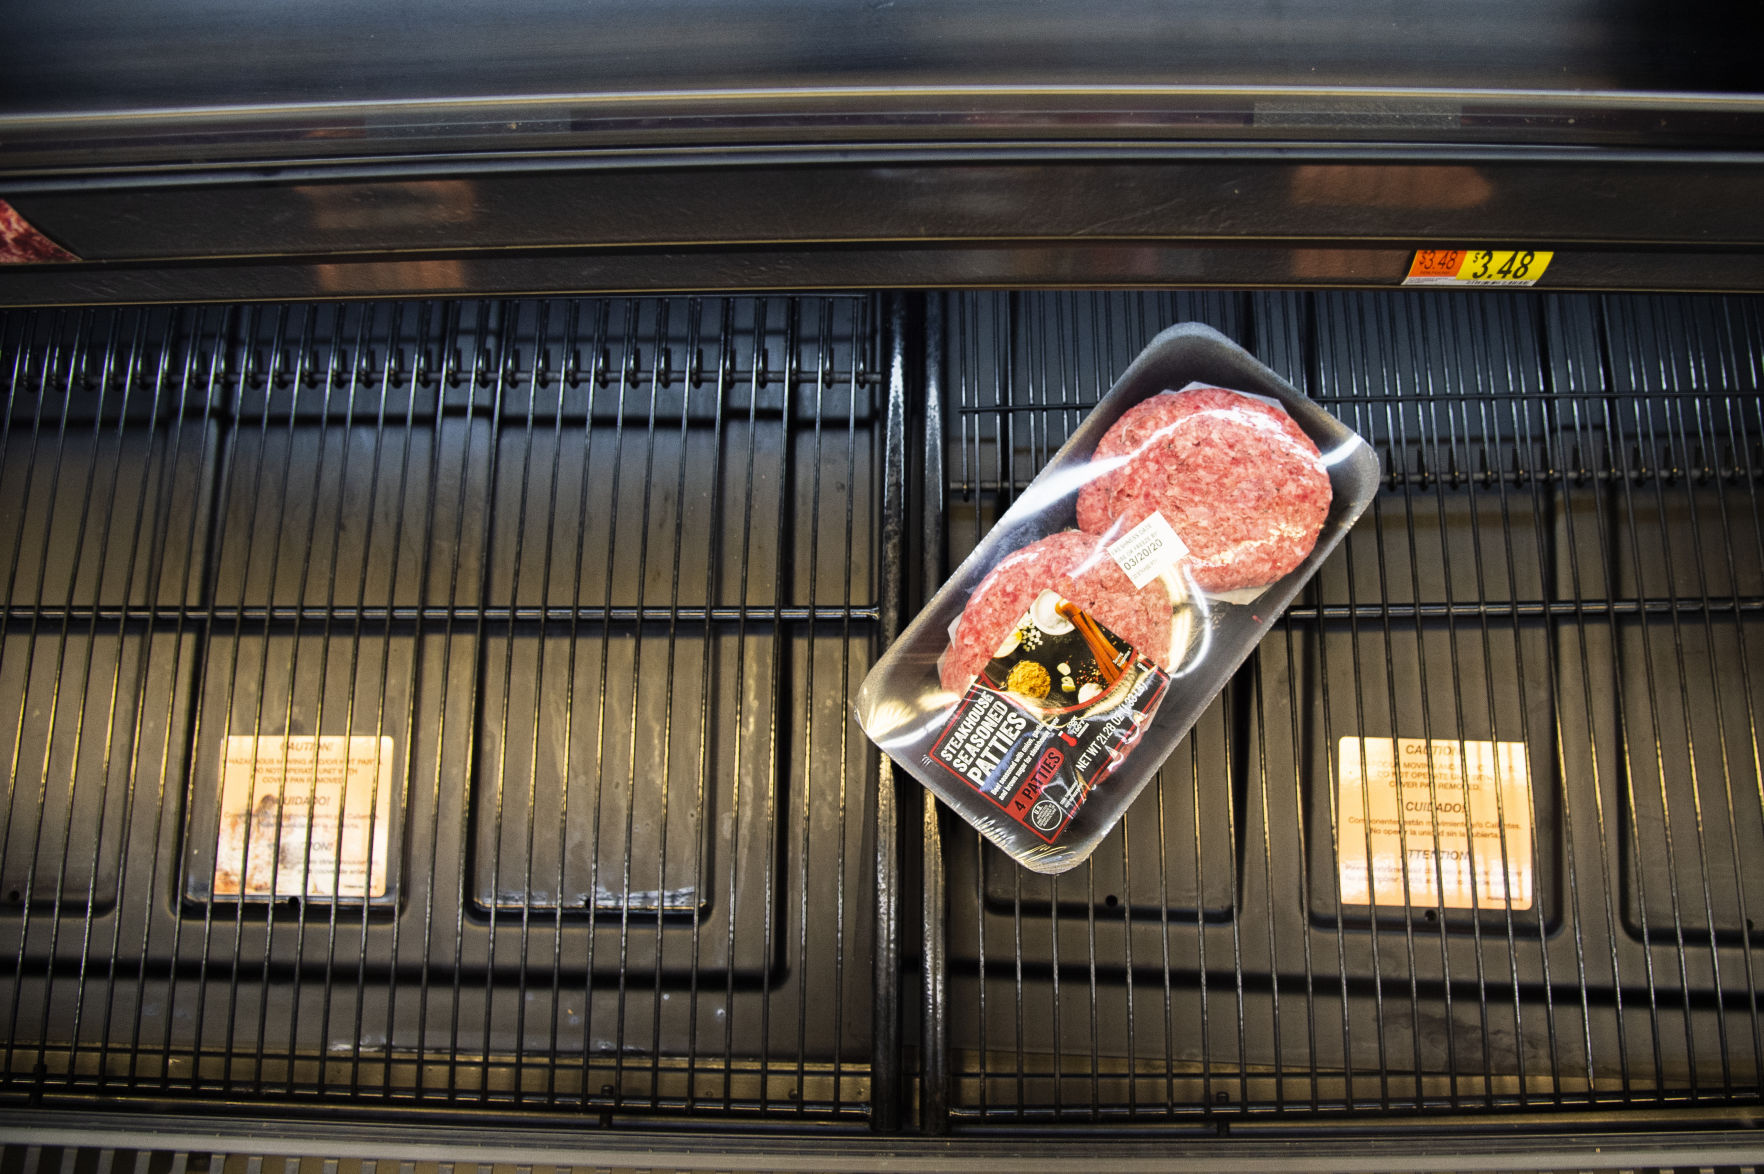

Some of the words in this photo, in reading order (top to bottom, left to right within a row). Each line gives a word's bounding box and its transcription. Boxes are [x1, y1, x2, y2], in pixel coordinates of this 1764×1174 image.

[1419, 250, 1458, 270] $3.48
[1472, 251, 1535, 279] $3.48
[1122, 537, 1164, 571] 03/20/20
[938, 689, 995, 762] STEAKHOUSE
[951, 698, 1010, 774] SEASONED
[966, 708, 1029, 787] PATTIES
[1075, 752, 1093, 772] NET
[1085, 739, 1103, 757] WT
[1094, 721, 1117, 745] 21.28
[1109, 709, 1125, 726] OZ
[997, 760, 1018, 785] seasoned
[1012, 749, 1025, 763] with
[997, 788, 1009, 801] and
[1003, 774, 1019, 791] brown
[1013, 761, 1029, 778] sugar
[1022, 754, 1033, 764] for
[1011, 798, 1027, 813] 4
[1021, 750, 1061, 800] PATTIES
